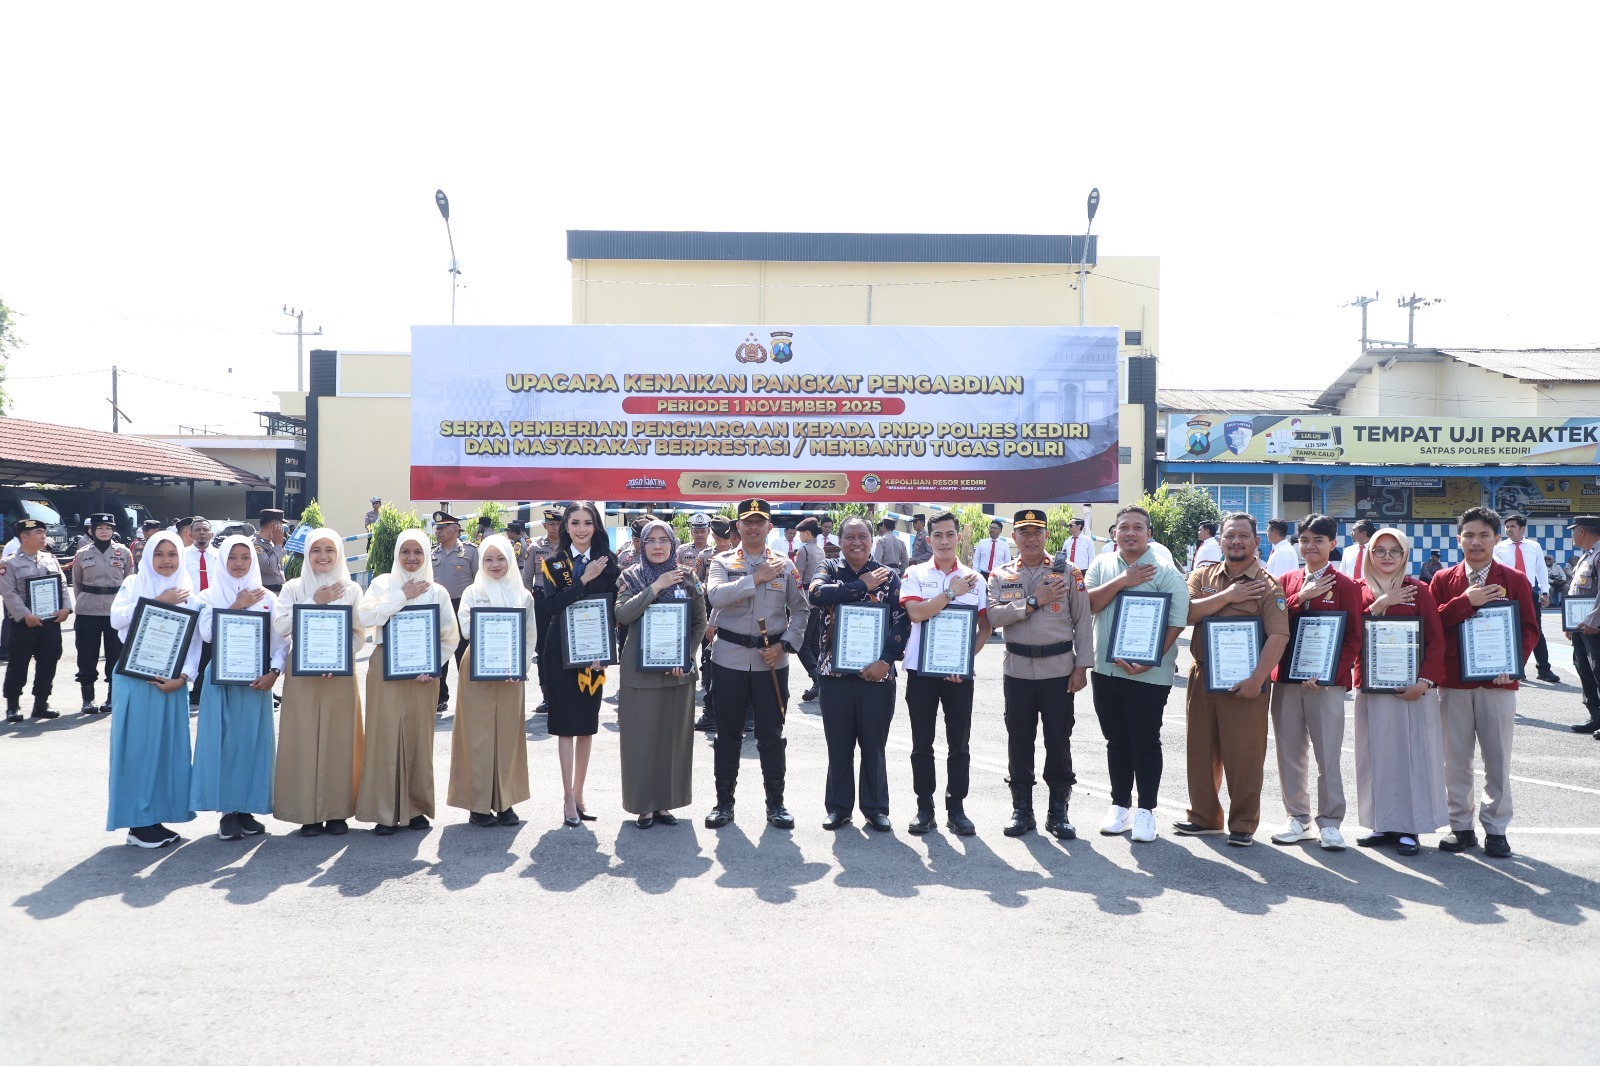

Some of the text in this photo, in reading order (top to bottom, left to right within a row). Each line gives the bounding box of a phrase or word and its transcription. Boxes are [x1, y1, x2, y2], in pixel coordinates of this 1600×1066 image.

[506, 373, 1024, 395] UPACARA KENAIKAN PANGKAT PENGABDIAN
[657, 400, 882, 413] PERIODE 1 NOVEMBER 2025
[440, 420, 1089, 439] SERTA PEMBERIAN PENGHARGAAN KEPADA PNPP POLRES KEDIRI
[1353, 426, 1598, 443] TEMPAT UJI PRAKTEK
[465, 439, 1065, 458] DAN MASYARAKAT BERPRESTASI / MEMBANTU TUGAS POLRI
[1419, 446, 1531, 455] SATPAS POLRES KEDIRI
[692, 478, 836, 490] Pare, 3 November 2025
[884, 478, 931, 486] KEPOLISIAN
